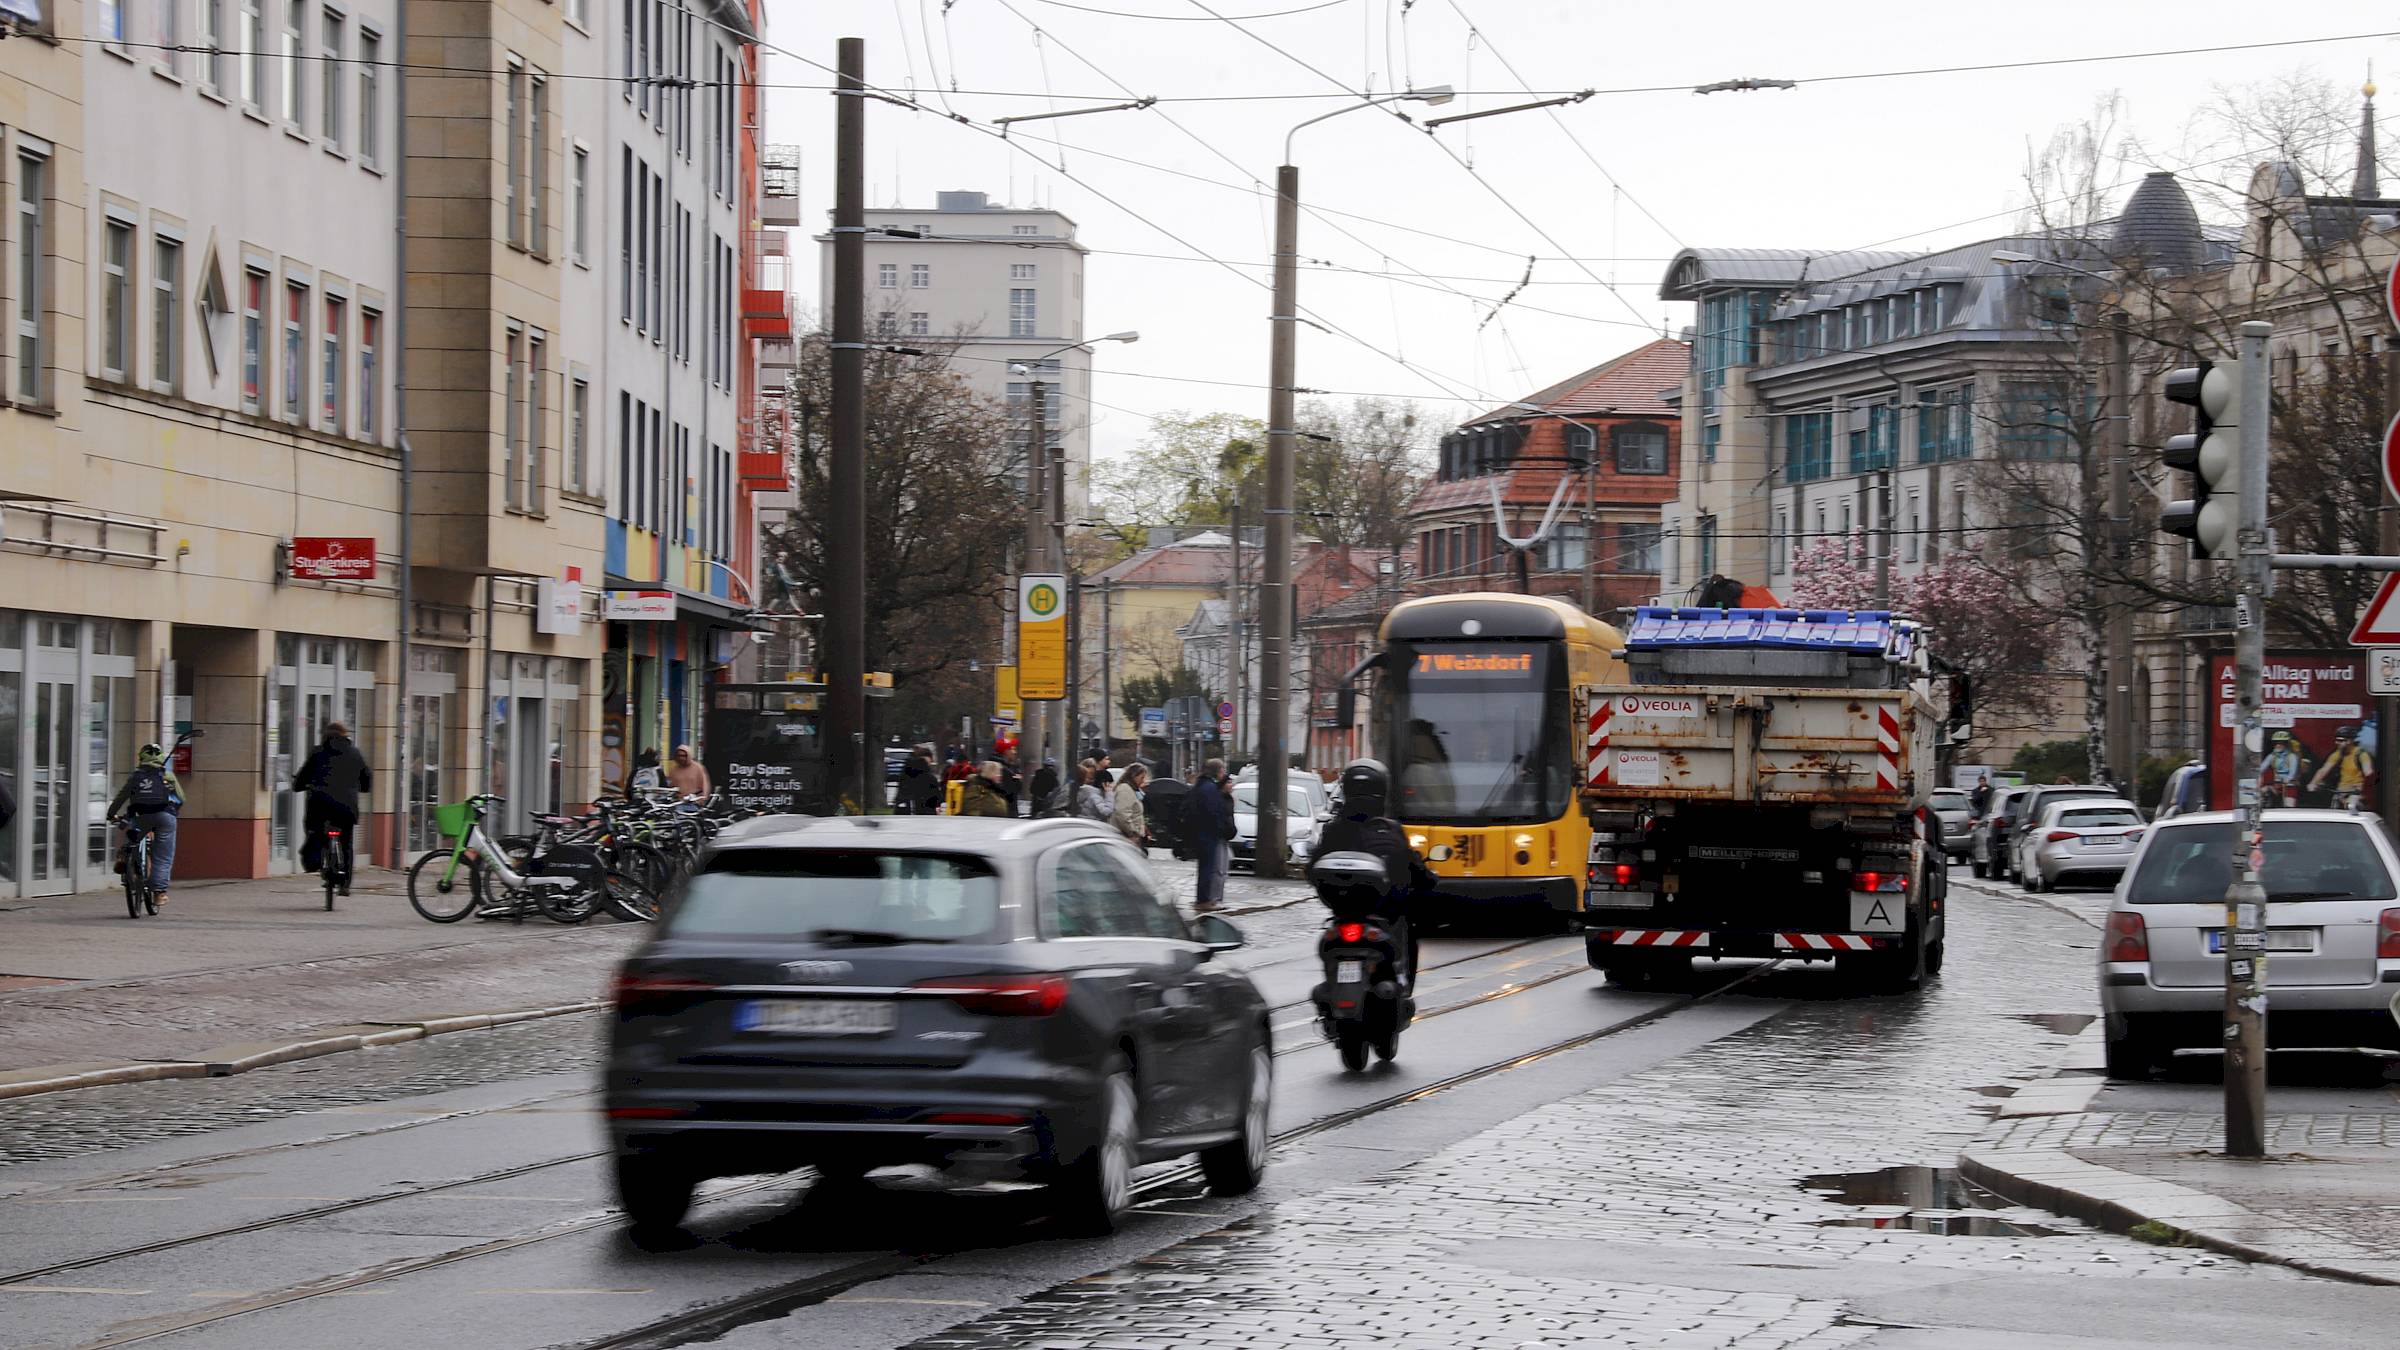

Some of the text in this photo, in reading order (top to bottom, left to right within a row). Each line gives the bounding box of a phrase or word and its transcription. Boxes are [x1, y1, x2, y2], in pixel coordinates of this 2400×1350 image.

[295, 556, 370, 568] Studienkreis
[1035, 590, 1049, 609] H
[1418, 654, 1532, 672] 7 Weixdorf
[2261, 665, 2354, 683] Alltag wird
[2221, 684, 2309, 698] ETRA!
[1642, 701, 1691, 711] VEOLIA
[729, 763, 792, 776] Day Spar:
[760, 779, 772, 790] %
[773, 779, 802, 790] aufs
[728, 794, 793, 807] Tagesgeld
[1864, 899, 1892, 926] A
